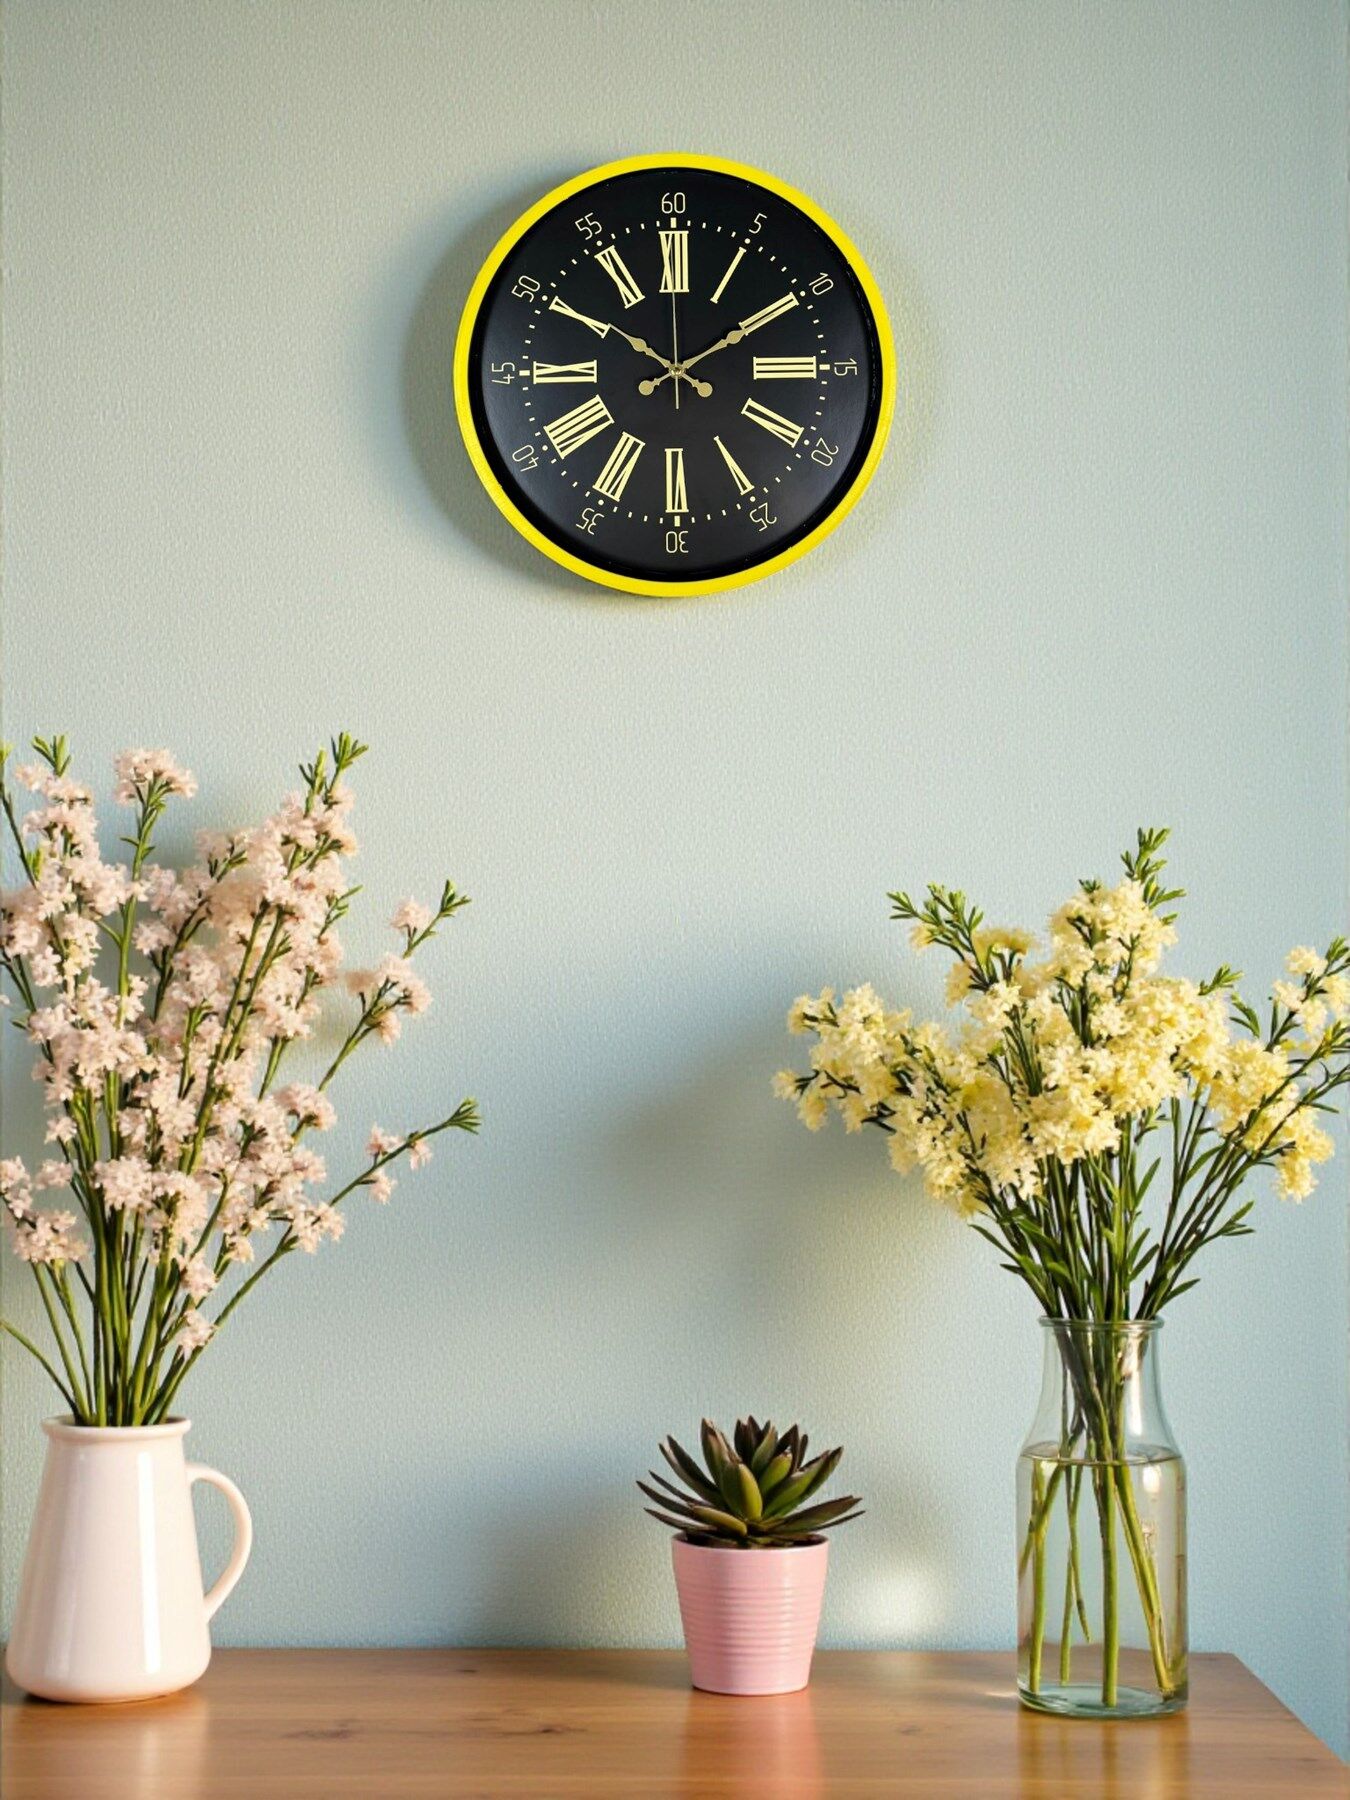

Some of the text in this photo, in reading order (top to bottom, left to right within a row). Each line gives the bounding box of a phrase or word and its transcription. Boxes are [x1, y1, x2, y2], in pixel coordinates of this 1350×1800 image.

[662, 193, 685, 213] 60
[575, 213, 602, 239] 55
[749, 213, 767, 233] 5
[659, 231, 689, 292] XII
[710, 247, 746, 303] I
[512, 276, 540, 302] 50
[594, 244, 645, 309] XI
[809, 273, 833, 295] 10
[549, 296, 611, 338] X
[491, 362, 515, 384] 45
[533, 360, 597, 384] IX
[753, 356, 816, 380] III
[834, 358, 857, 376] 15
[543, 395, 614, 459] VIII
[741, 398, 805, 448] IV
[511, 445, 539, 472] 40
[714, 436, 754, 495] V
[811, 438, 839, 466] 20
[593, 432, 645, 501] VII
[665, 448, 689, 513] VI
[576, 512, 604, 535] 35
[750, 501, 777, 531] 25
[666, 531, 688, 553] 30
